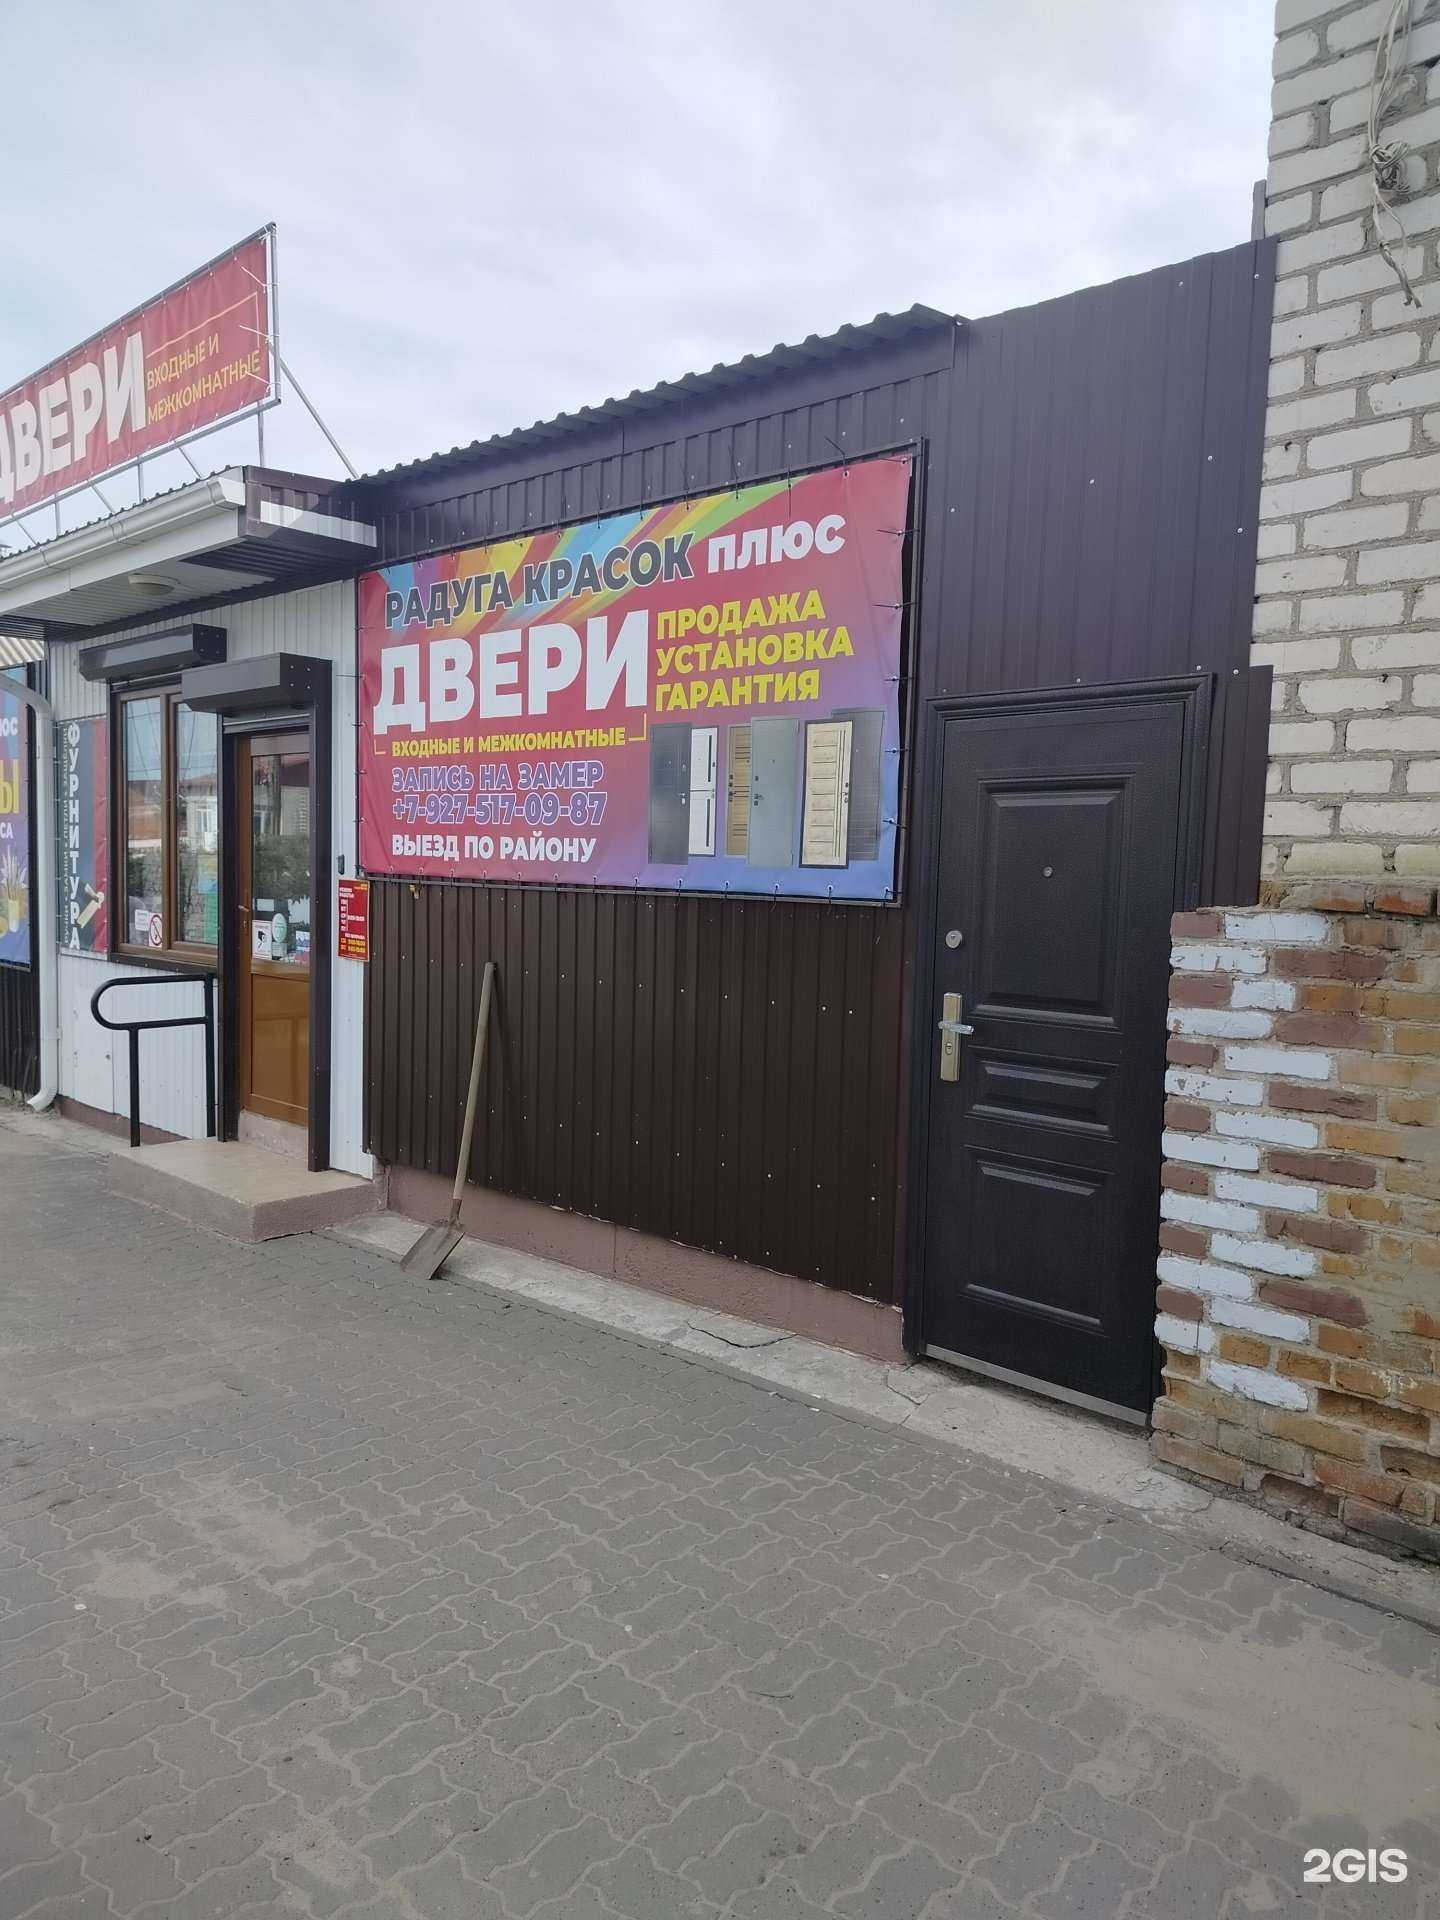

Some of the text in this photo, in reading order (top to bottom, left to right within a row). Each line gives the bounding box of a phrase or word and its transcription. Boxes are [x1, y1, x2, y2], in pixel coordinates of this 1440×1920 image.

[147, 333, 219, 391] ВХОДНЫЕ И
[148, 350, 260, 424] МЕЖКОМНАТНЫЕ
[385, 514, 846, 629] РАДУГА КРАСОК ПЛЮС
[657, 589, 826, 640] ПРОДАЖА
[373, 609, 648, 735] ДВЕРИ
[656, 626, 854, 676] УСТАНОВКА
[655, 669, 820, 712] ГАРАНТИЯ
[392, 727, 626, 758] ВХОДНЫЕ И МЕЖКОМНАТНЫЕ
[391, 760, 604, 792] ЗАПИСЬ НА ЗАМЕР
[392, 791, 607, 825] +7-927-517-09-87
[68, 722, 80, 950] ФУРНИТУРА
[392, 830, 597, 863] ВЫЕЗД ПО РАЙОНУ
